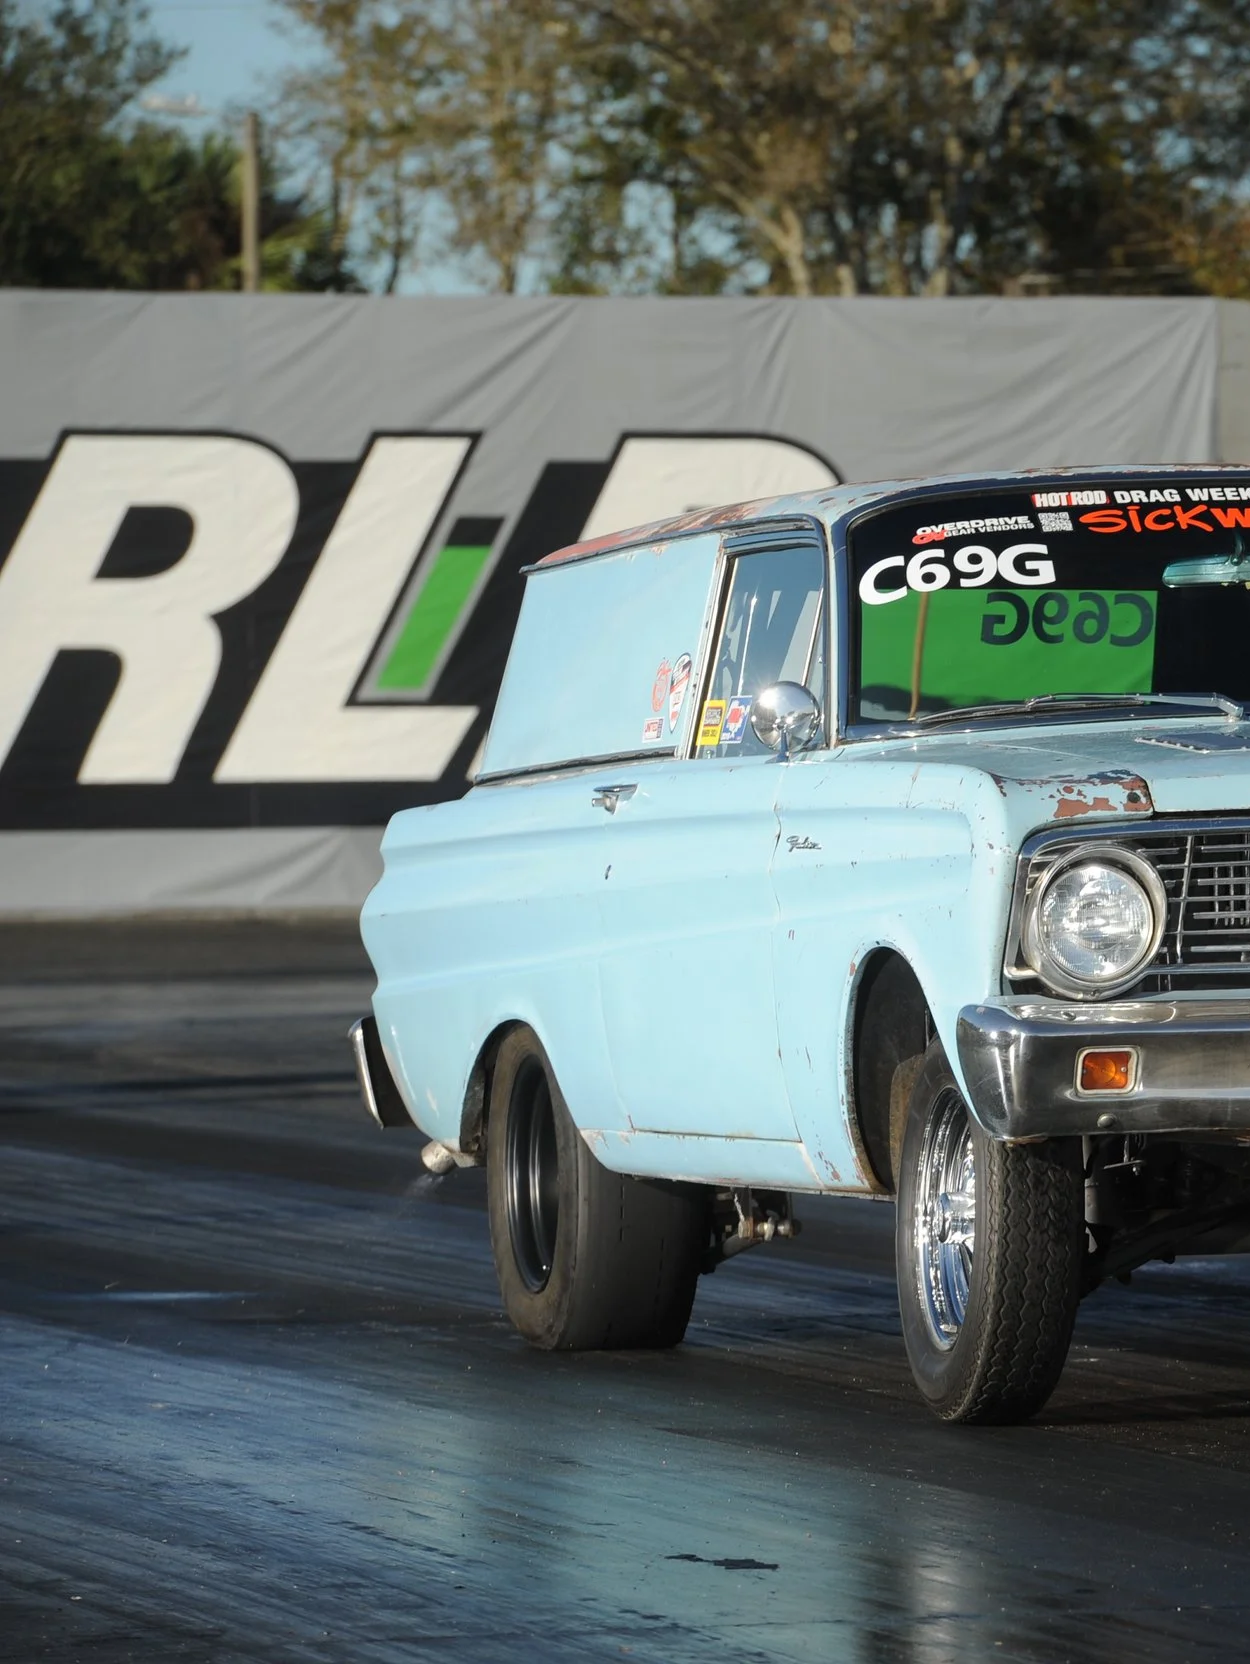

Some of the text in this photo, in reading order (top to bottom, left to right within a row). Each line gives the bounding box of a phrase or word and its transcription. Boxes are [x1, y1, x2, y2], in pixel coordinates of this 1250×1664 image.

[1113, 488, 1181, 504] DRAG
[916, 515, 1031, 535] OVERDRIVE
[944, 522, 1035, 538] GEAR VENDORS
[859, 543, 1056, 605] C69G
